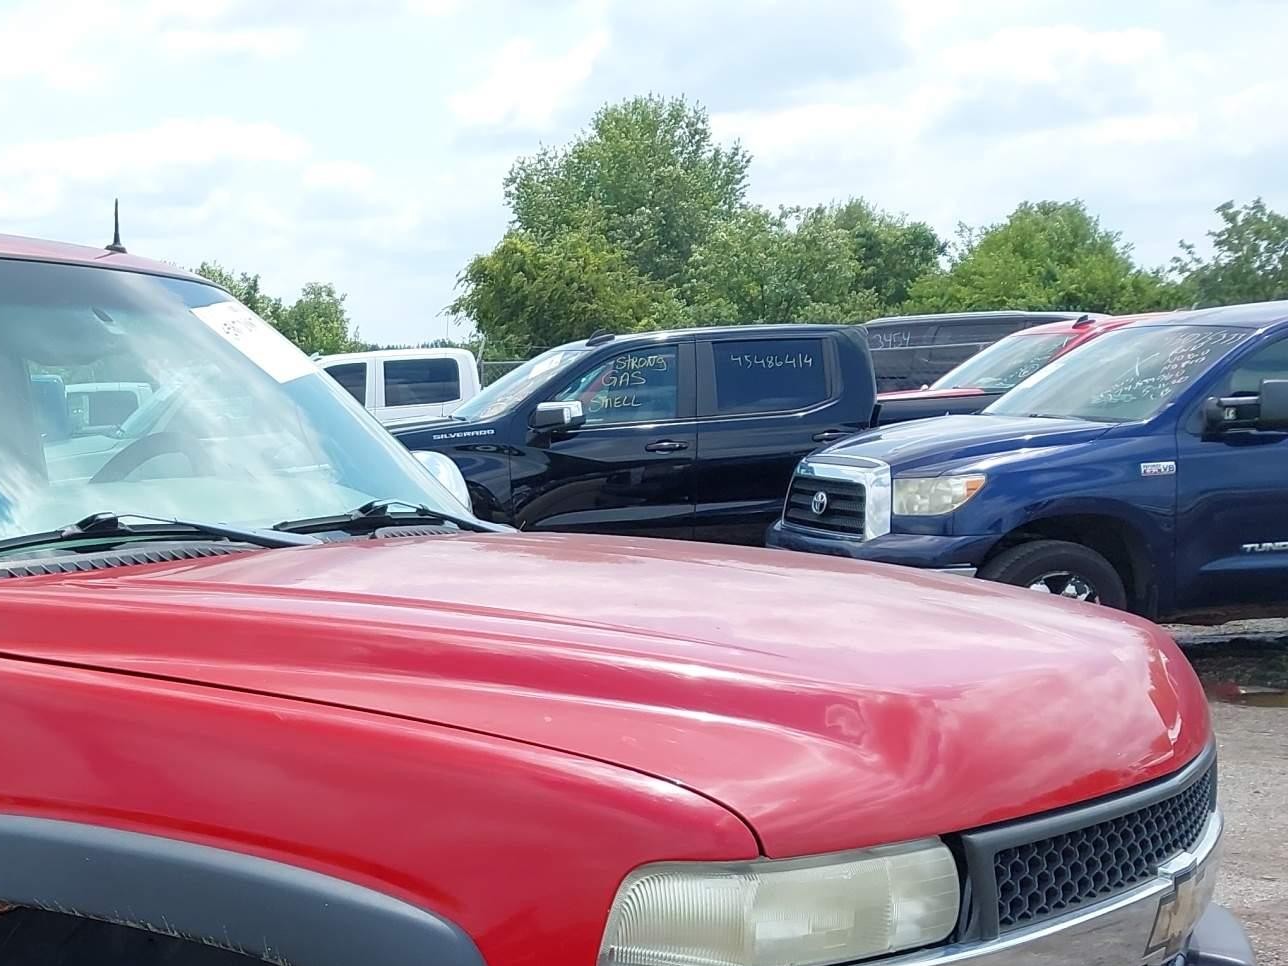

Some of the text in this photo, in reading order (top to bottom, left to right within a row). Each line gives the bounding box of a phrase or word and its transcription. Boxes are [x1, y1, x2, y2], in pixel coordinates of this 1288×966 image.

[730, 353, 813, 369] 45486414
[601, 369, 647, 387] GAS
[588, 395, 642, 413] SMELL
[432, 429, 495, 440] SILVERADO
